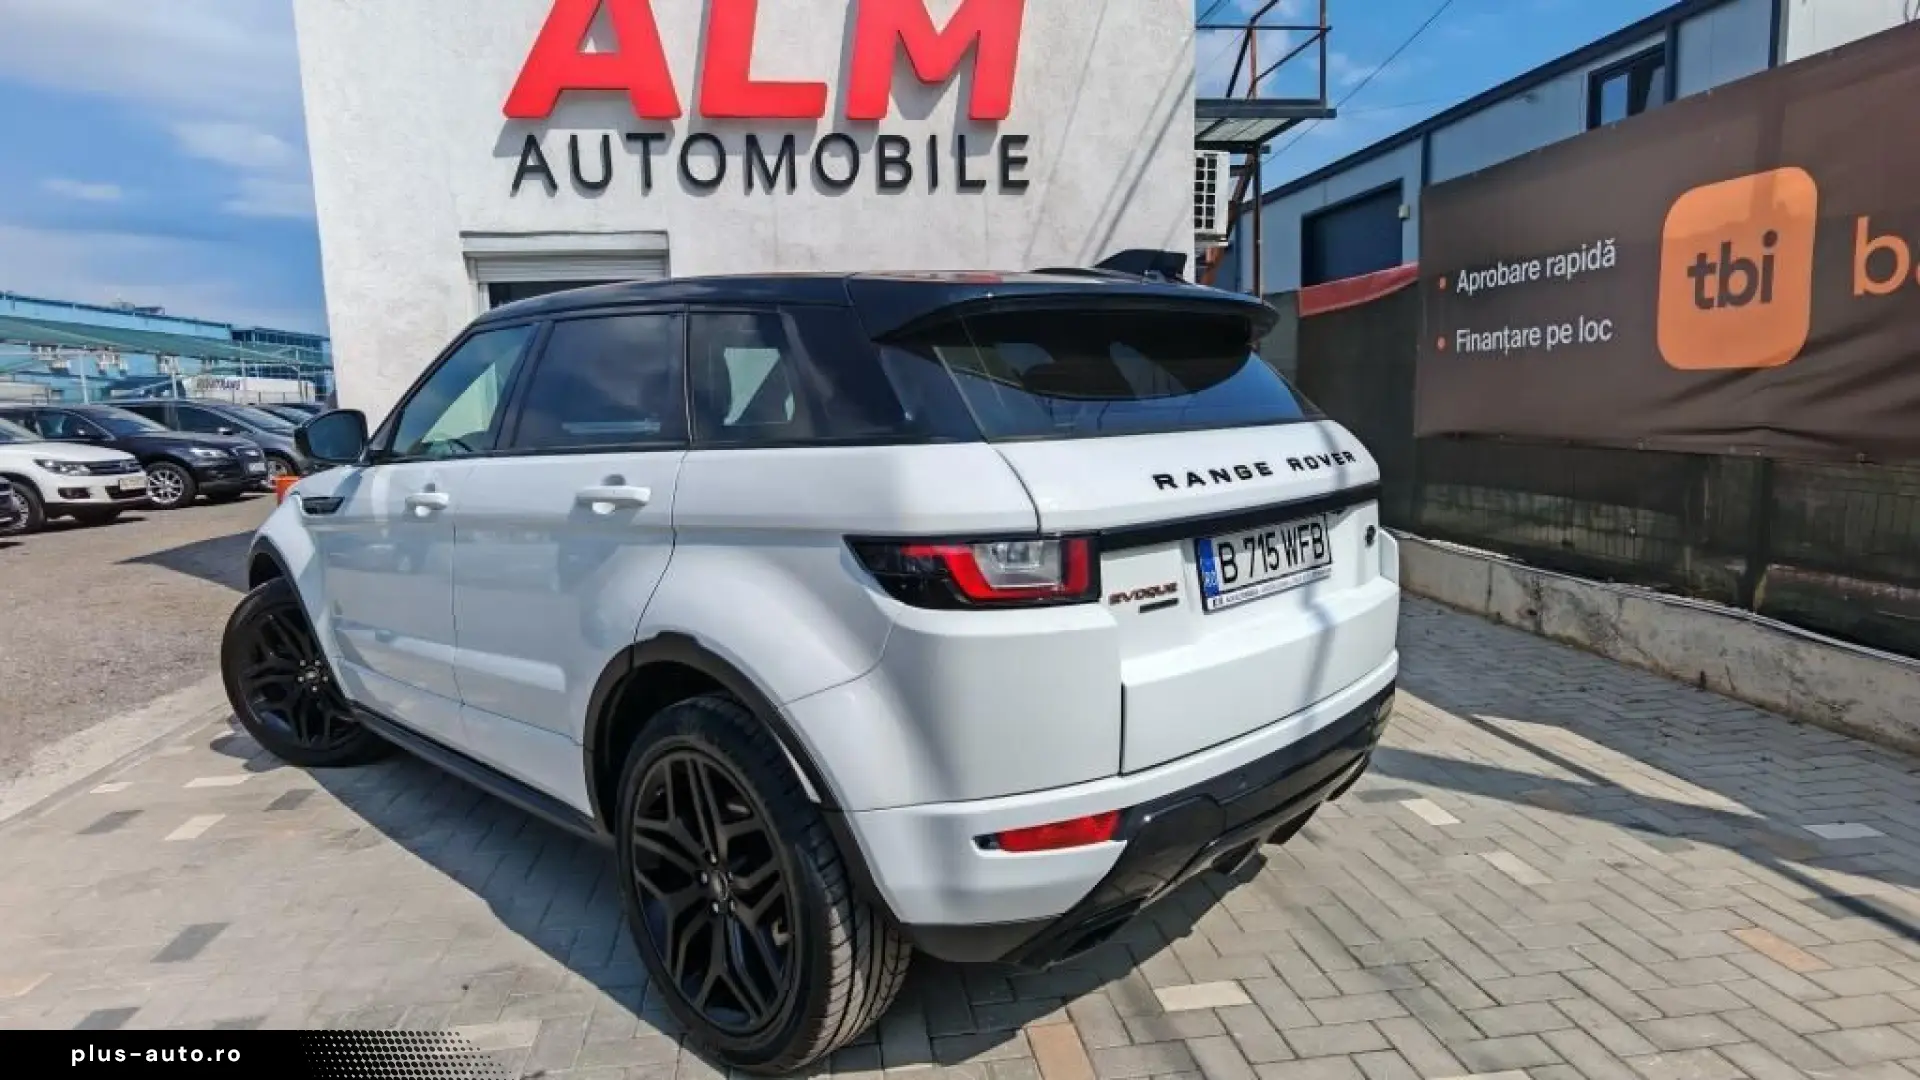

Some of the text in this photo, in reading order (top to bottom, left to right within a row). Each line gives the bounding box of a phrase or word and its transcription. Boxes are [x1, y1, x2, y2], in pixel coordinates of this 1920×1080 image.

[503, 0, 1026, 120] ALM
[511, 133, 1030, 192] AUTOMOBILE
[1456, 237, 1617, 296] Aprobare rapidă
[1687, 229, 1778, 310] tbi
[1853, 216, 1920, 296] b
[1456, 314, 1613, 355] Finanțare pe loc
[1151, 451, 1356, 490] RANGE ROVER
[1217, 541, 1239, 584] B
[1243, 530, 1280, 578] 715
[1281, 522, 1325, 566] WFB
